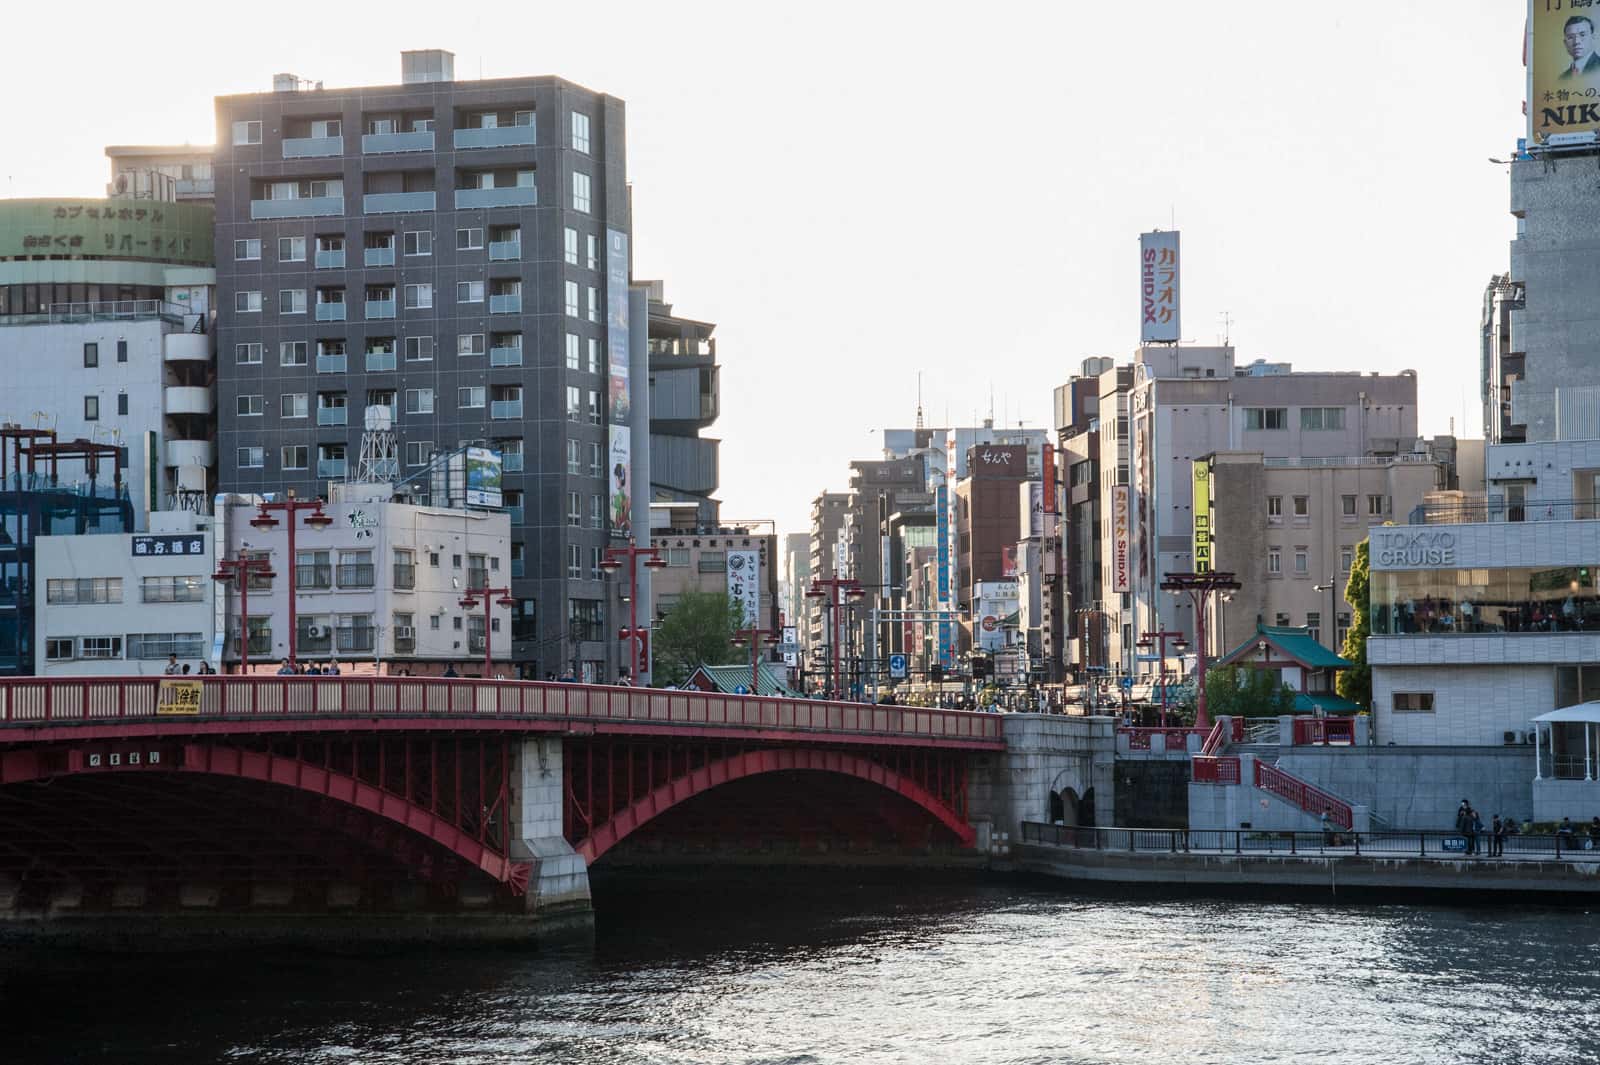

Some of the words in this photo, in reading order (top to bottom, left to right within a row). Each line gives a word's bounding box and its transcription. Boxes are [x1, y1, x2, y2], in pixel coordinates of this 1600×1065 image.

[1544, 88, 1600, 101] 本物への
[1541, 103, 1600, 127] NIK
[1144, 248, 1156, 324] SHIDAX
[1158, 247, 1175, 324] カラオケ
[1116, 491, 1126, 537] カラオケ
[1378, 532, 1456, 549] TOKYO
[1380, 549, 1456, 566] CRUISE
[1118, 540, 1126, 587] SHIDAX
